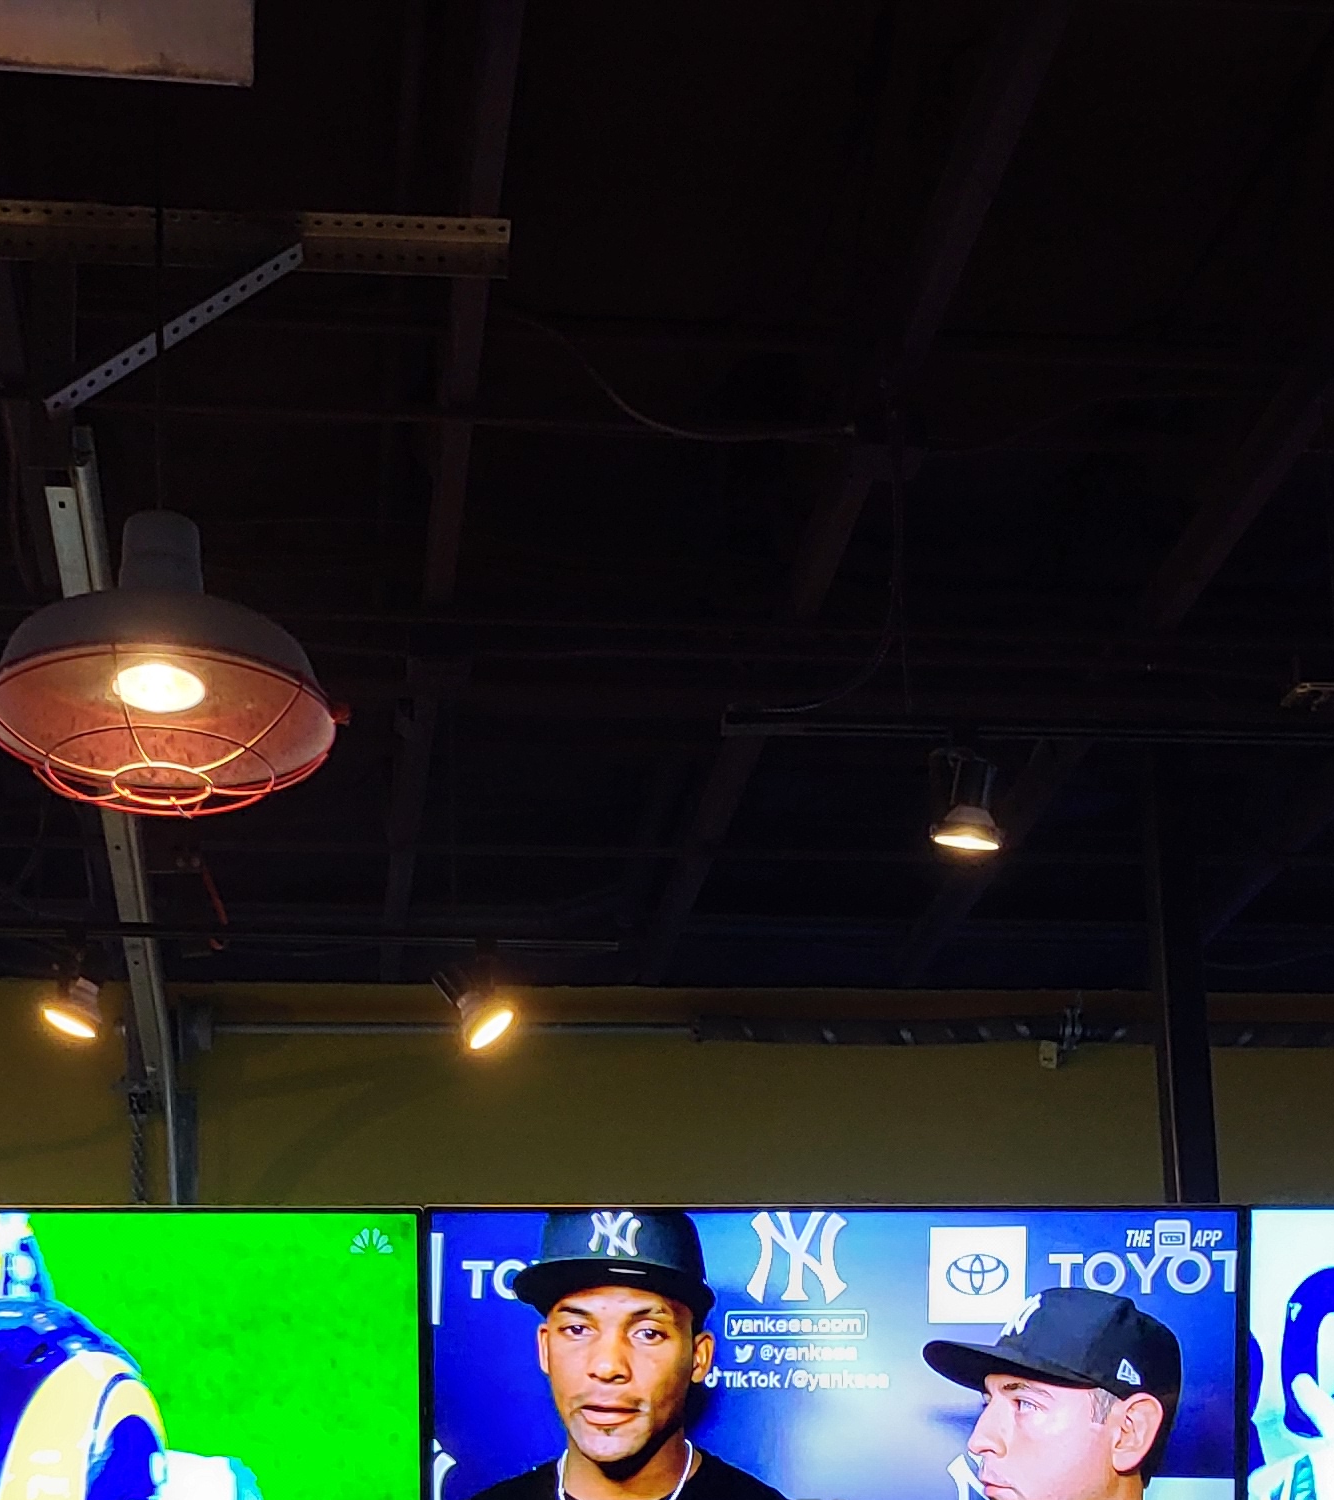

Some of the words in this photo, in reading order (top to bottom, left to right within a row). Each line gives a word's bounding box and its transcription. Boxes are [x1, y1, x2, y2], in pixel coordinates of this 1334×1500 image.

[1126, 1230, 1152, 1247] THE
[1192, 1230, 1222, 1247] APP
[724, 1369, 780, 1389] TikTok
